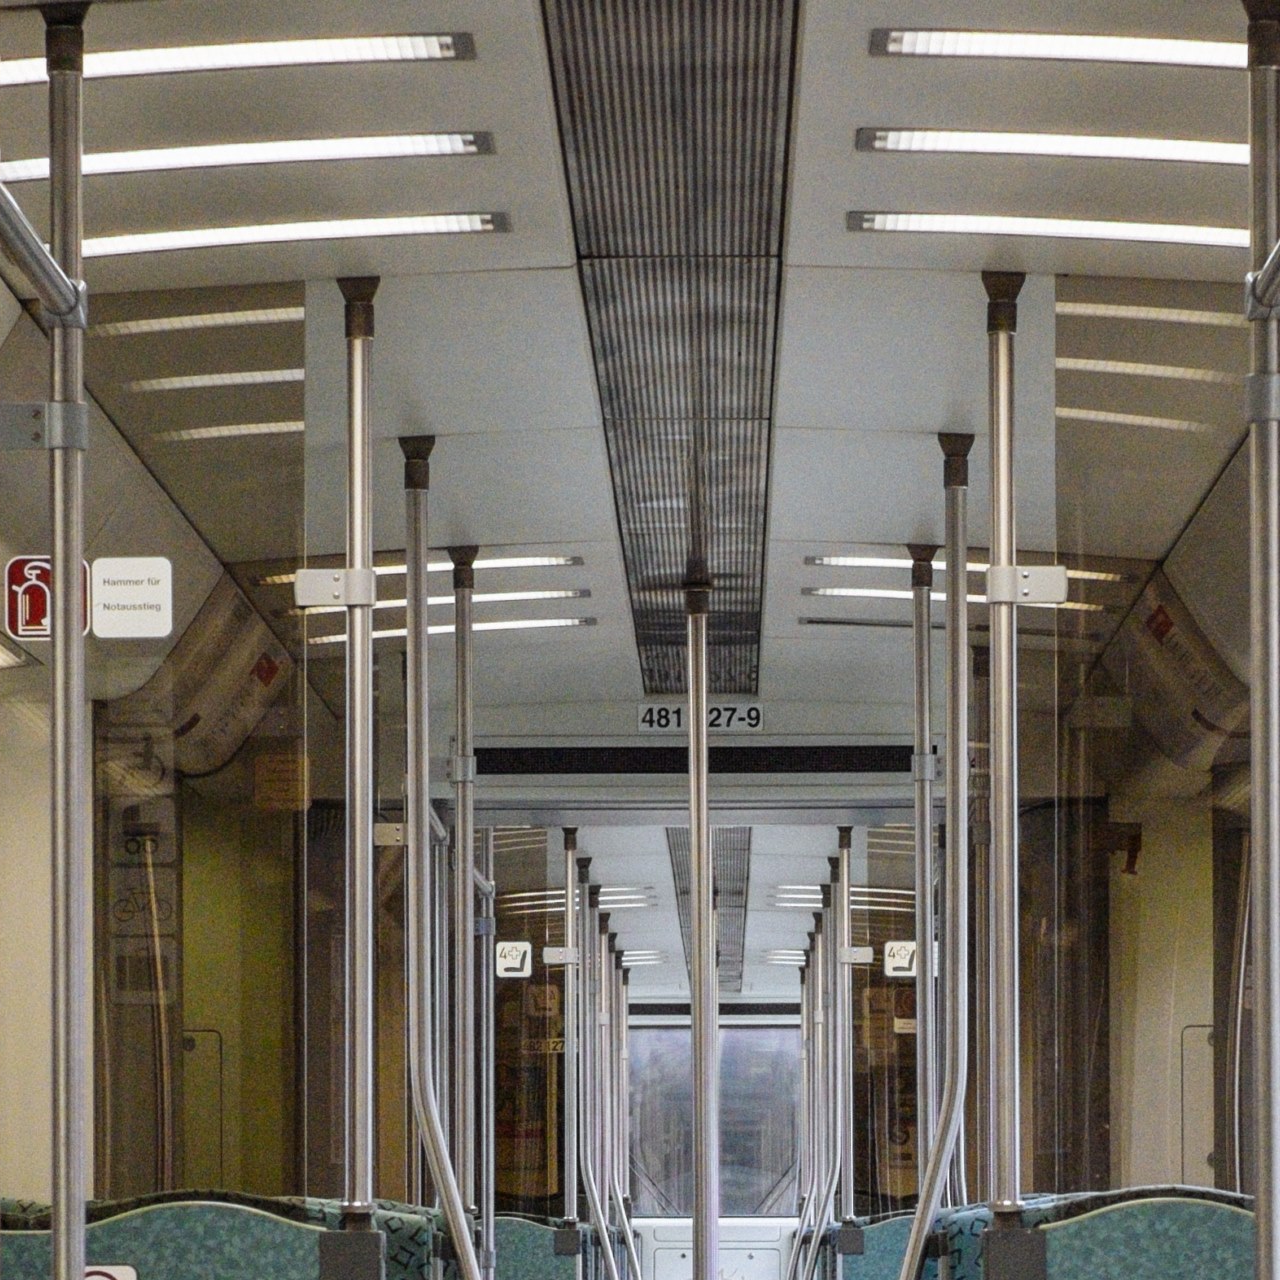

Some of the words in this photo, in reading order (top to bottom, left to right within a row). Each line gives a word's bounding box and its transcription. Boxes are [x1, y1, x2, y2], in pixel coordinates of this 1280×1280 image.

[102, 577, 144, 587] Hammer
[146, 577, 161, 587] für
[102, 601, 162, 613] Notausstieg
[641, 707, 682, 728] 481
[708, 706, 761, 728] 27-9
